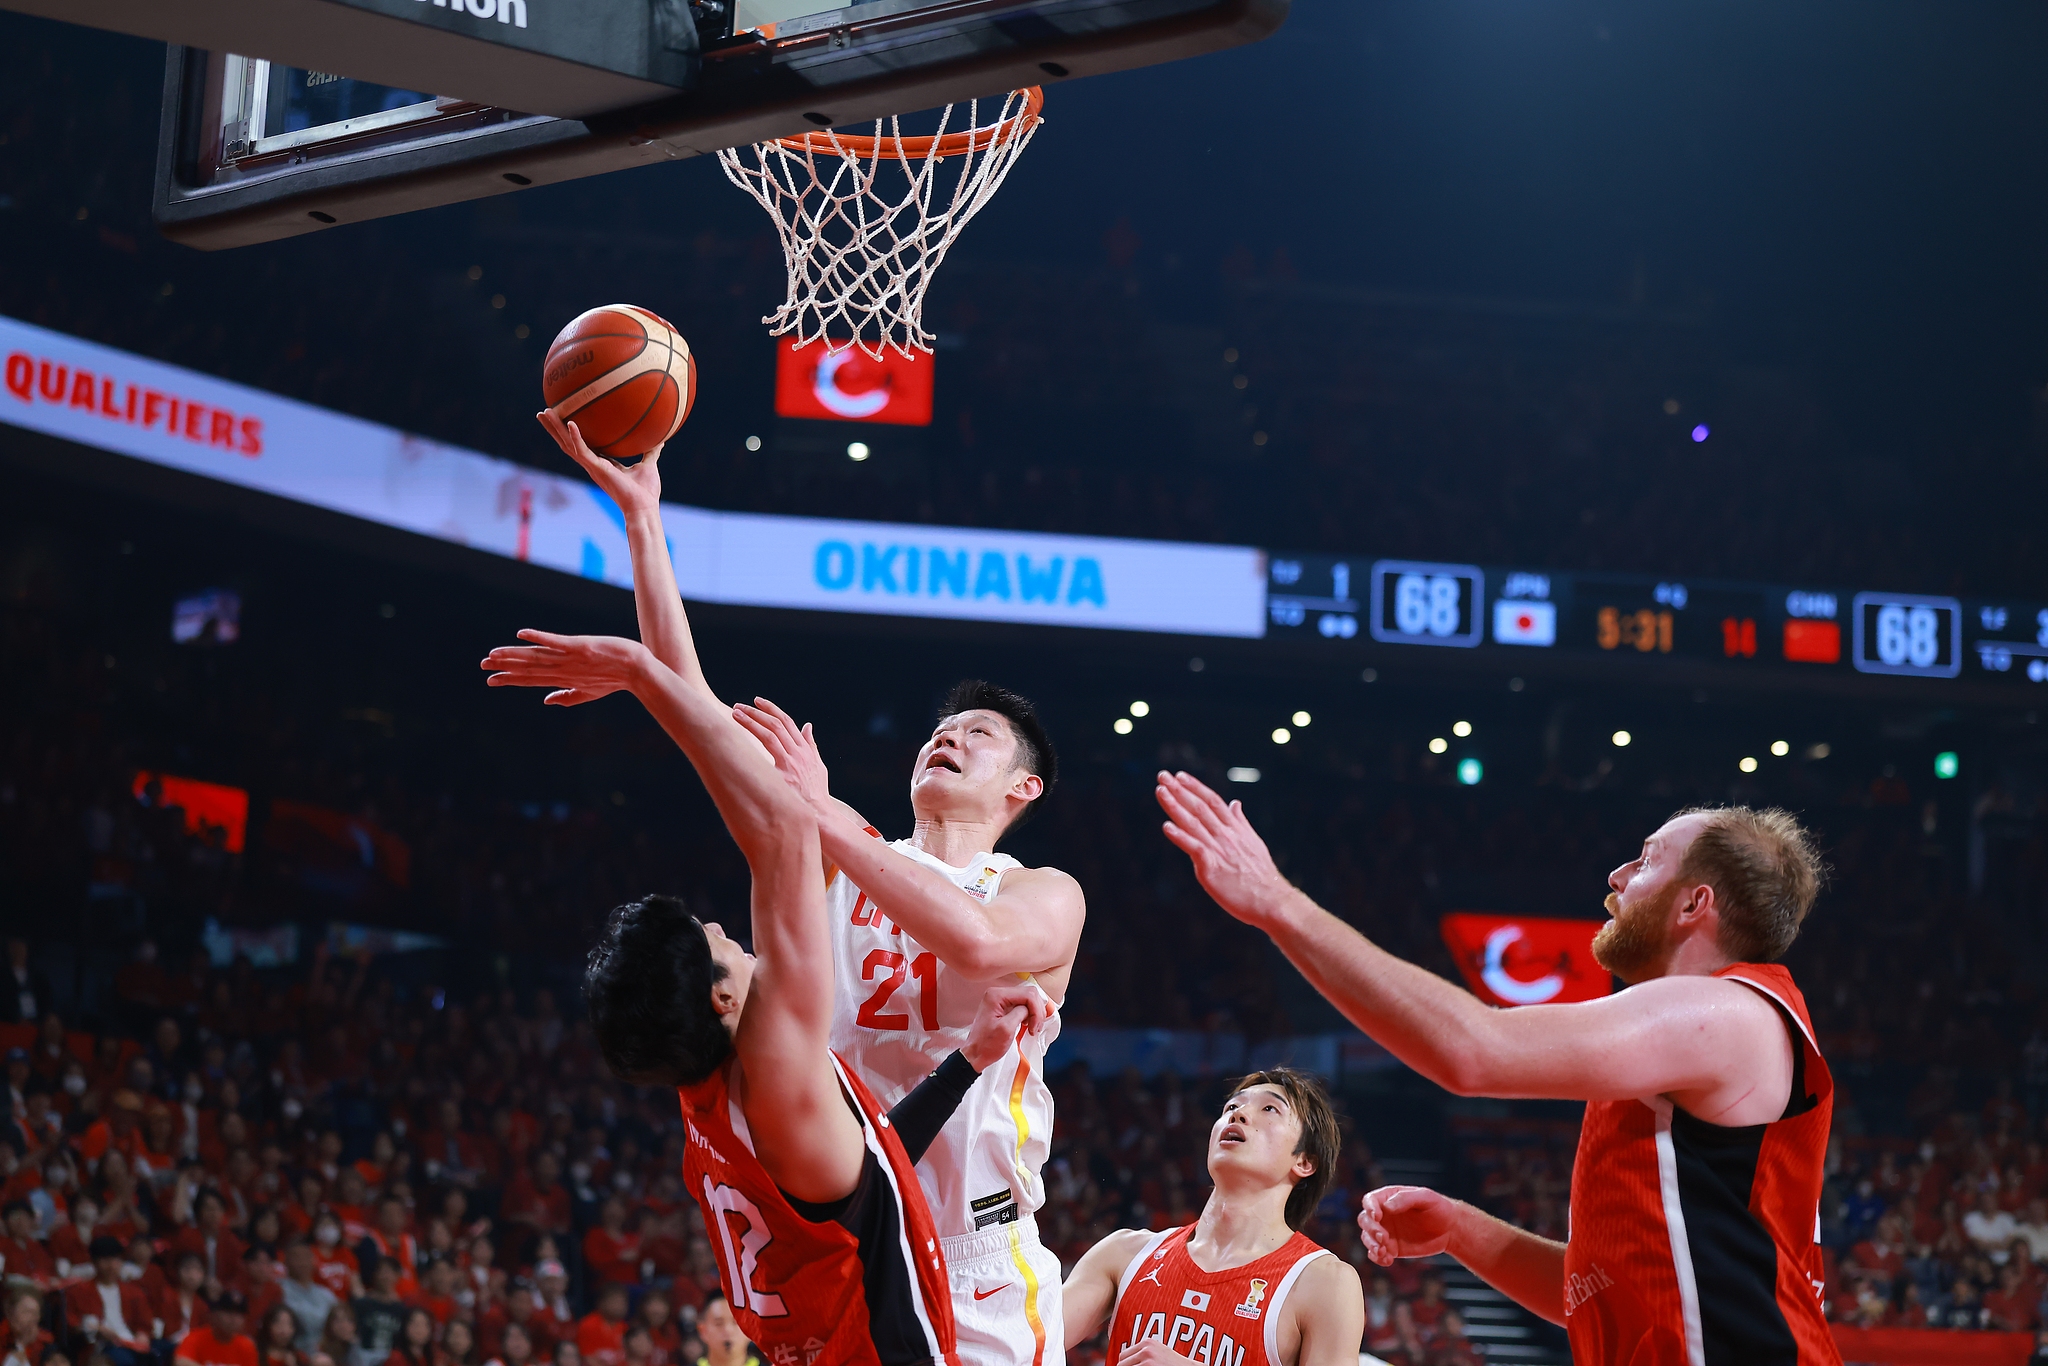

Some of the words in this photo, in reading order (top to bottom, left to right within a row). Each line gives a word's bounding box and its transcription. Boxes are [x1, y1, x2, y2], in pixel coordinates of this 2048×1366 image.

[547, 350, 594, 387] molten
[4, 352, 262, 458] QUALIFIERS
[814, 539, 1107, 609] OKINAWA
[1395, 573, 1459, 636] 68
[1505, 572, 1549, 599] JPN
[1786, 590, 1837, 618] CHN
[1598, 606, 1673, 652] 5:31
[1877, 603, 1938, 667] 68
[855, 949, 940, 1031] 21
[703, 1172, 789, 1317] 12
[1120, 1312, 1246, 1366] JAPAN
